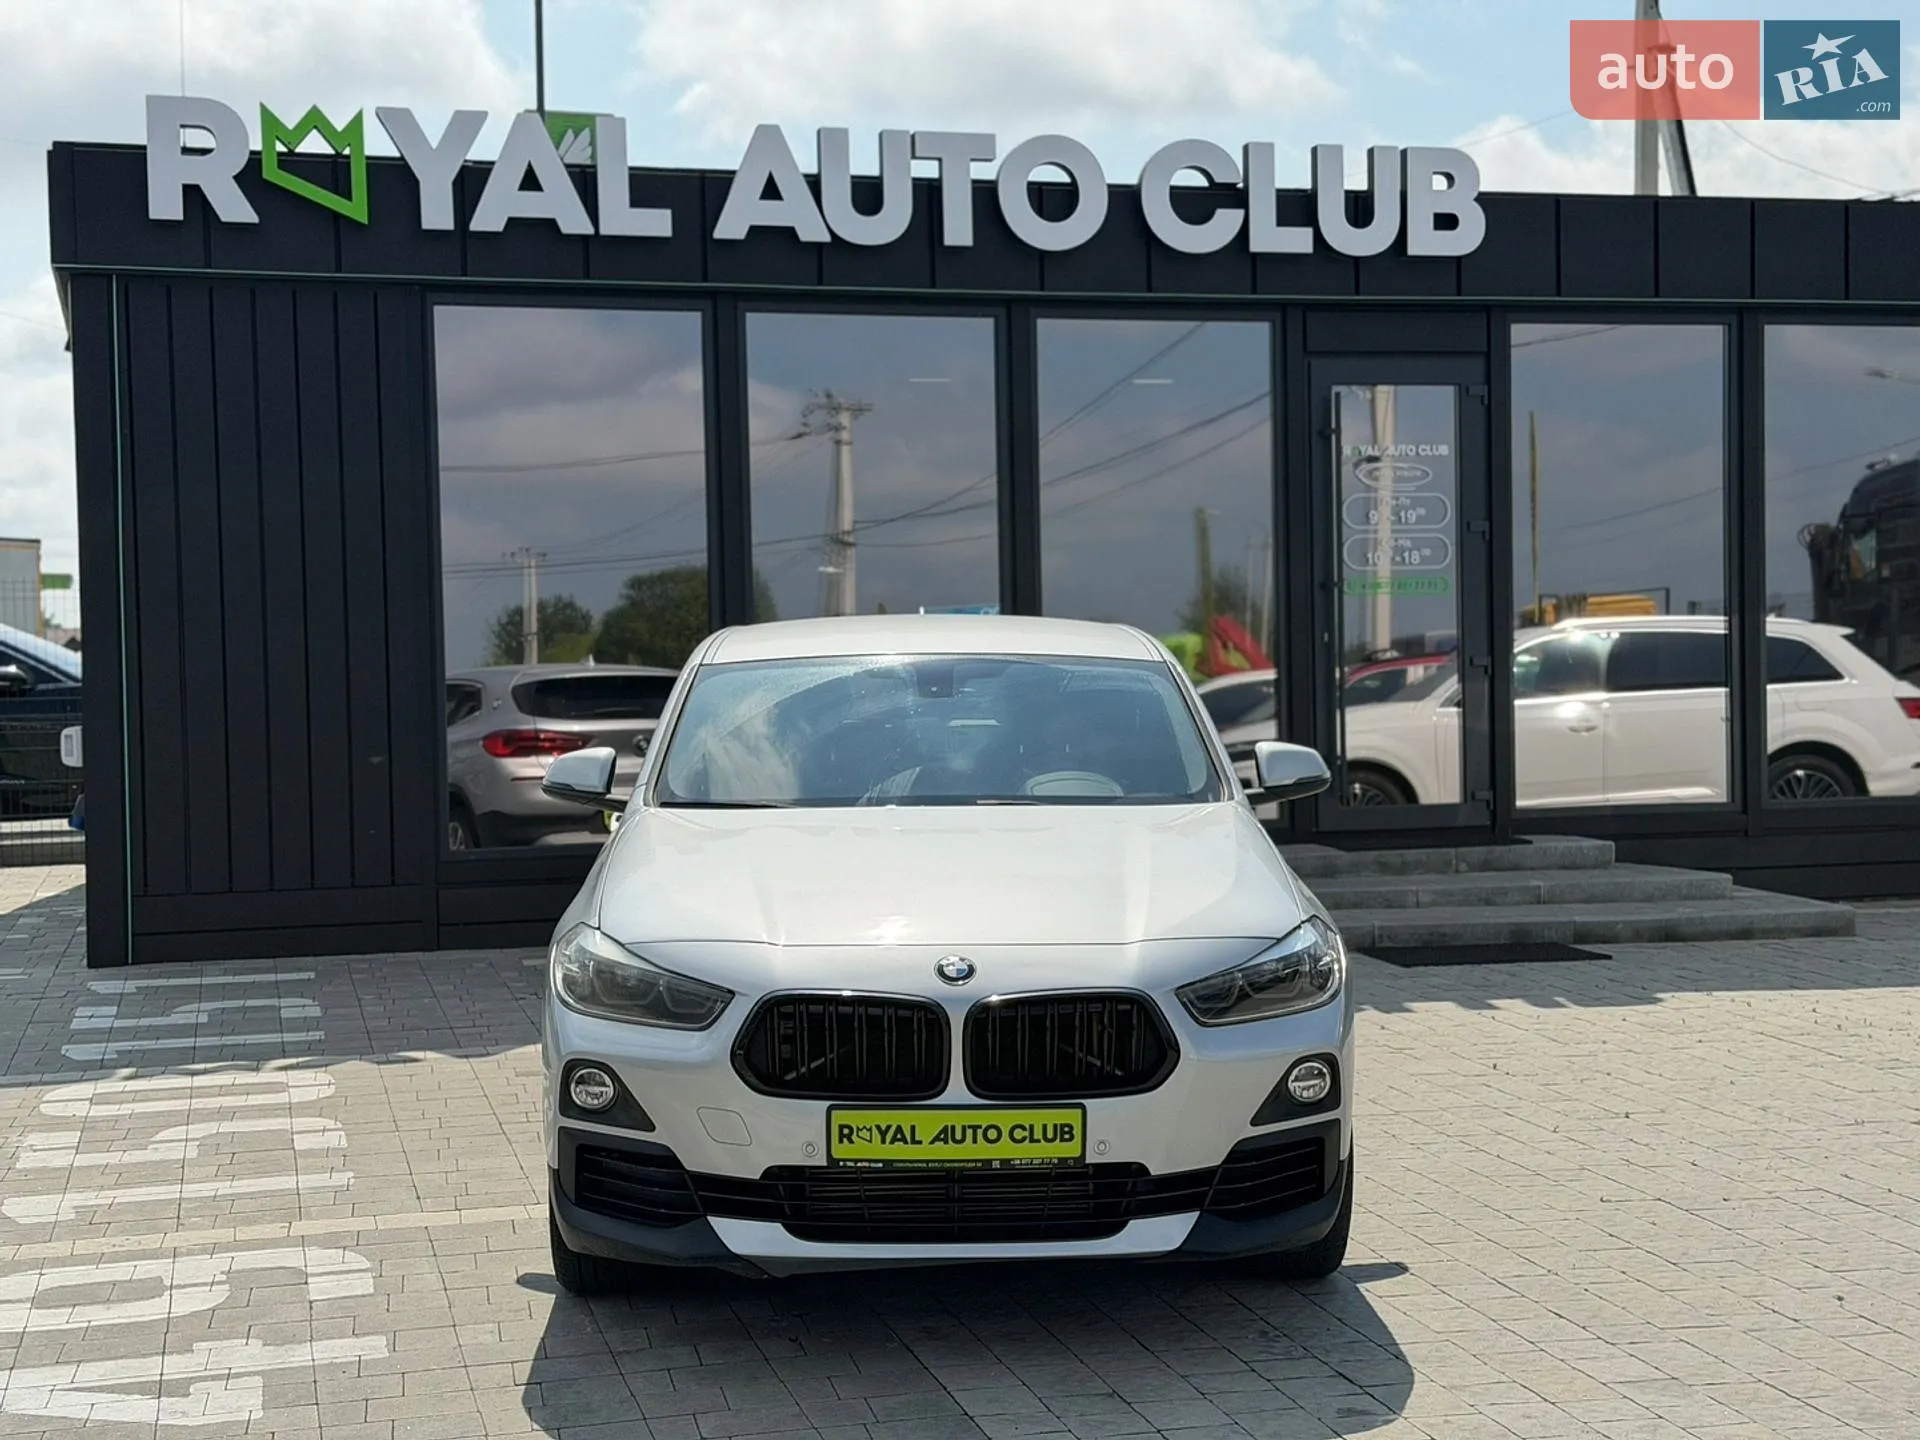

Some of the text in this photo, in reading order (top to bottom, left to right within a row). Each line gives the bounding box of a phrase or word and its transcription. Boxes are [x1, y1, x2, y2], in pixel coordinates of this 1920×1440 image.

[713, 124, 1110, 252] AUTO
[1139, 138, 1486, 258] CLUB
[1418, 444, 1450, 456] CLUB
[928, 1123, 1003, 1145] AUTO
[1008, 1122, 1076, 1144] CLUB
